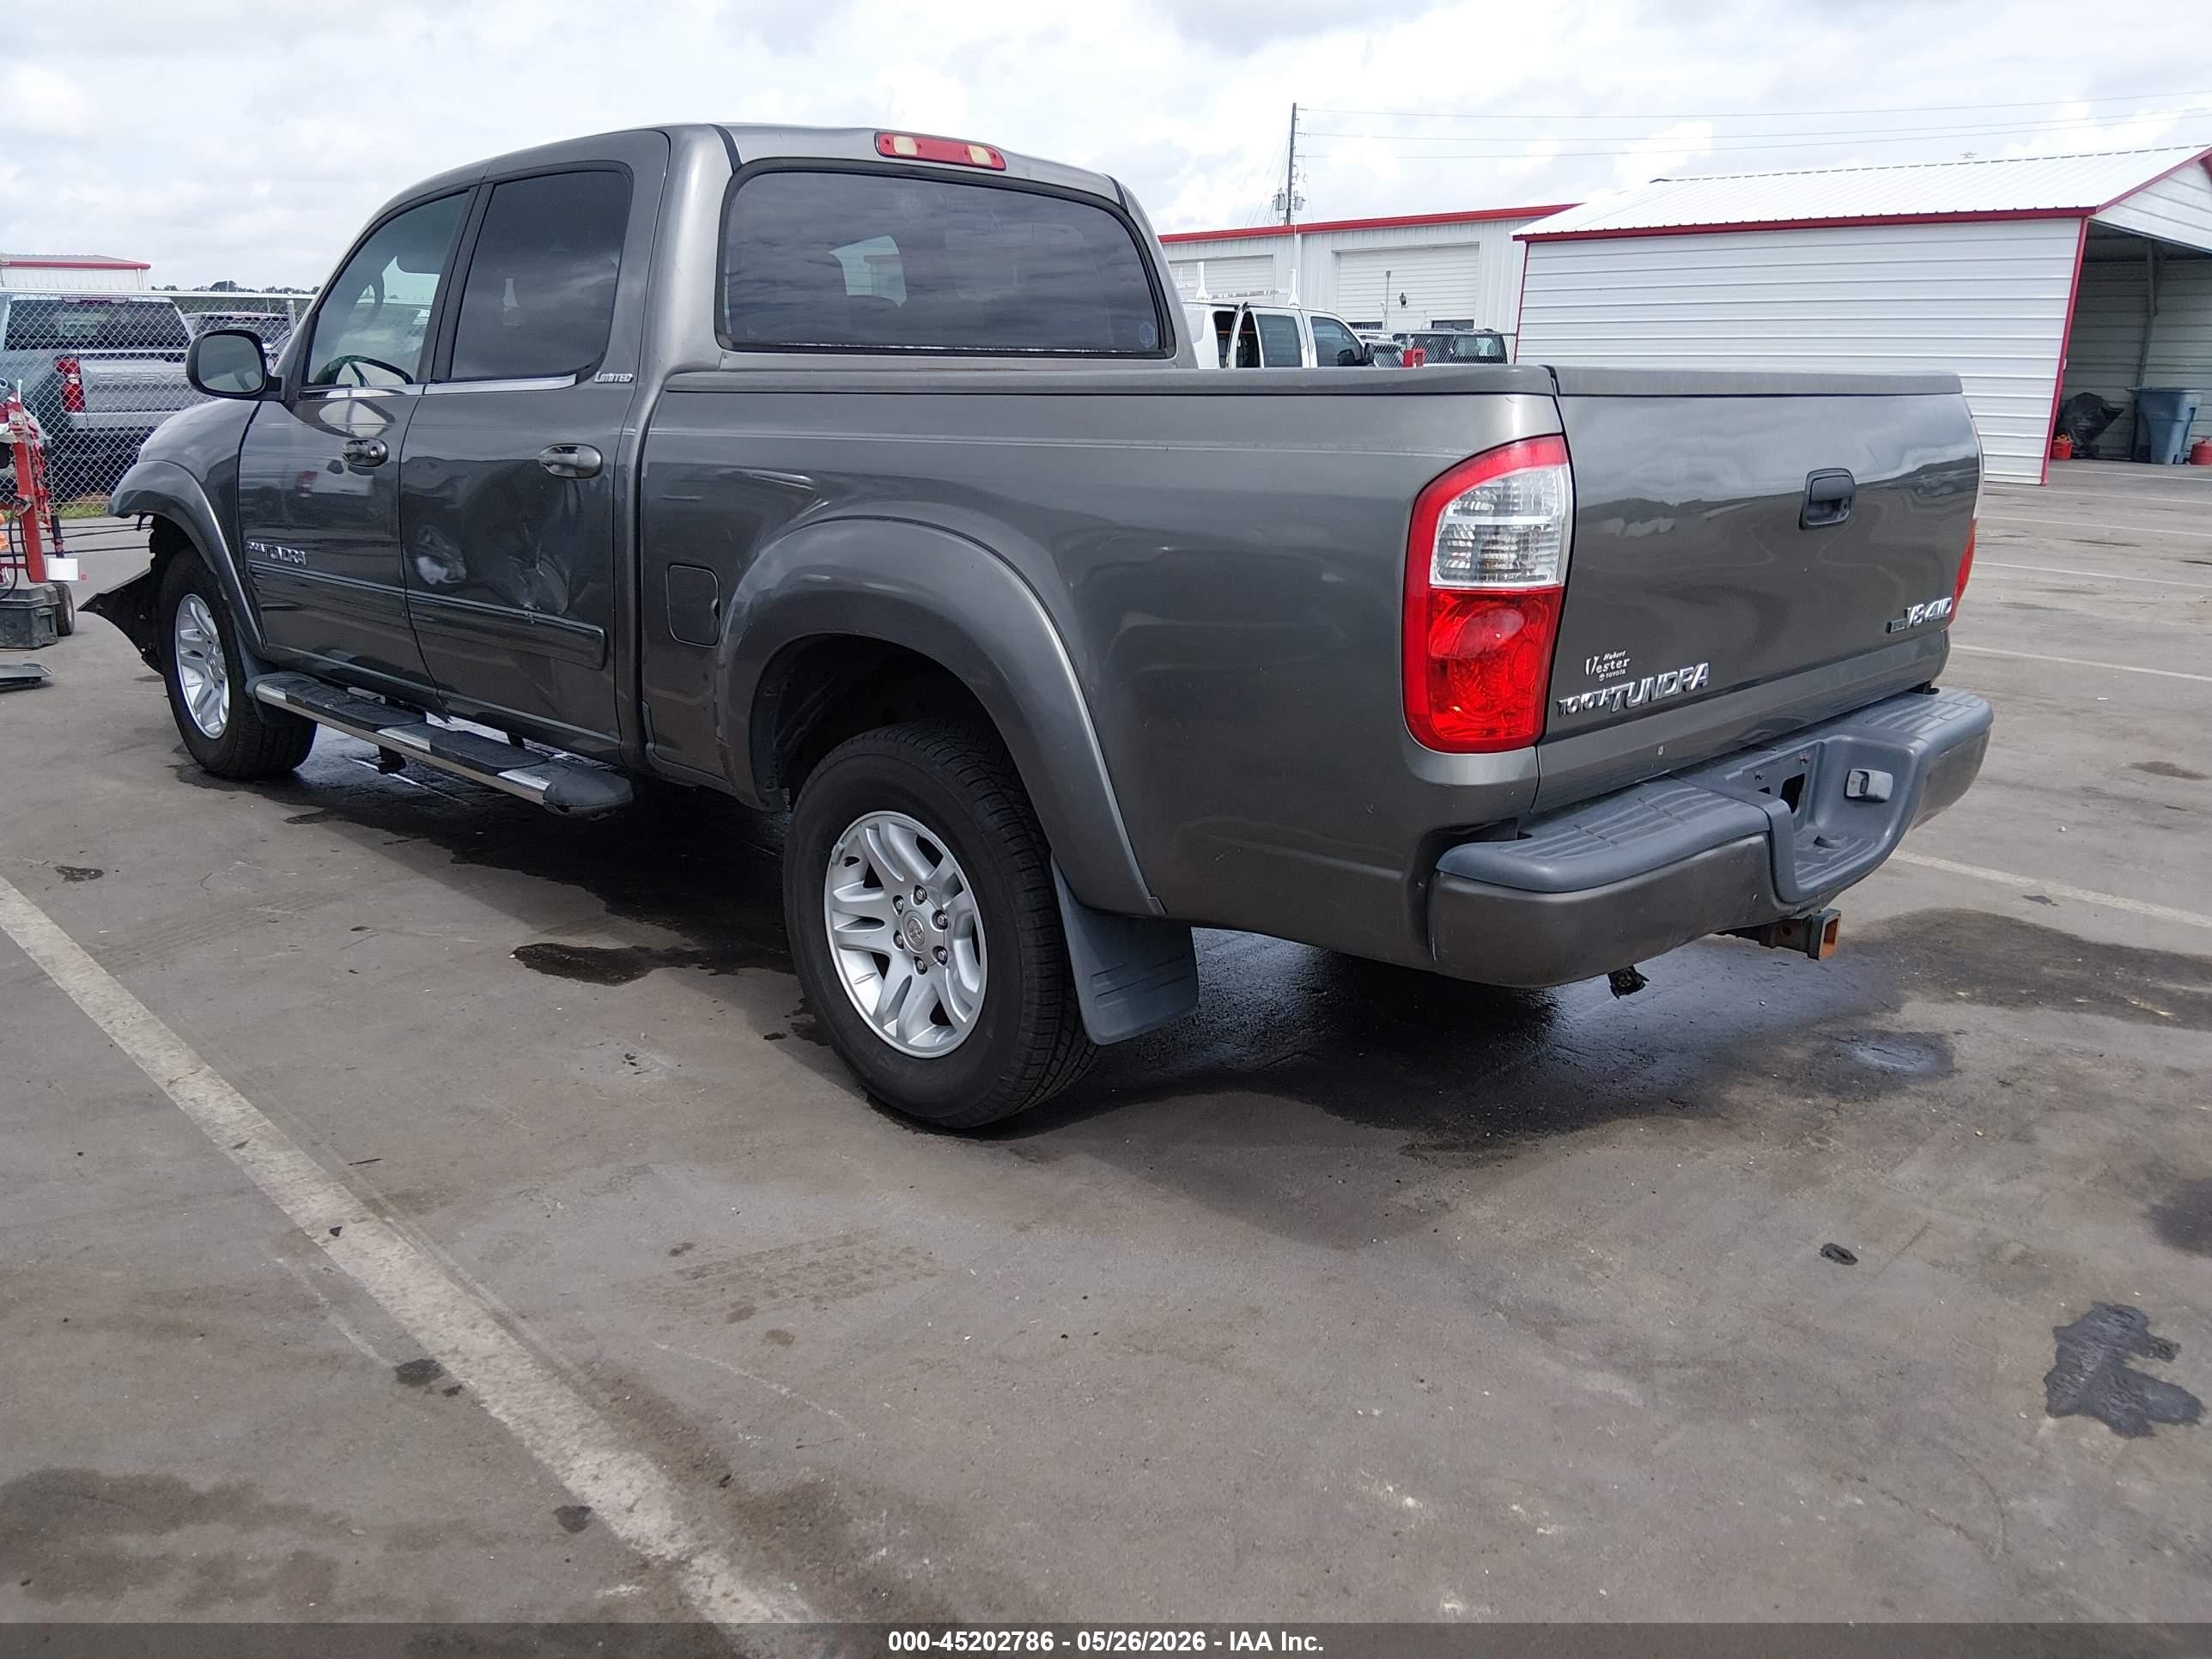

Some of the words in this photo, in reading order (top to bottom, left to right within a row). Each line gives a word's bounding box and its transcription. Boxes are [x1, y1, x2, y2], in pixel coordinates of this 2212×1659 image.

[1603, 650, 1626, 661] Hubert
[1585, 655, 1631, 676] Vester
[1605, 668, 1626, 679] TOYOTA
[1610, 662, 1709, 712] TUNDRA
